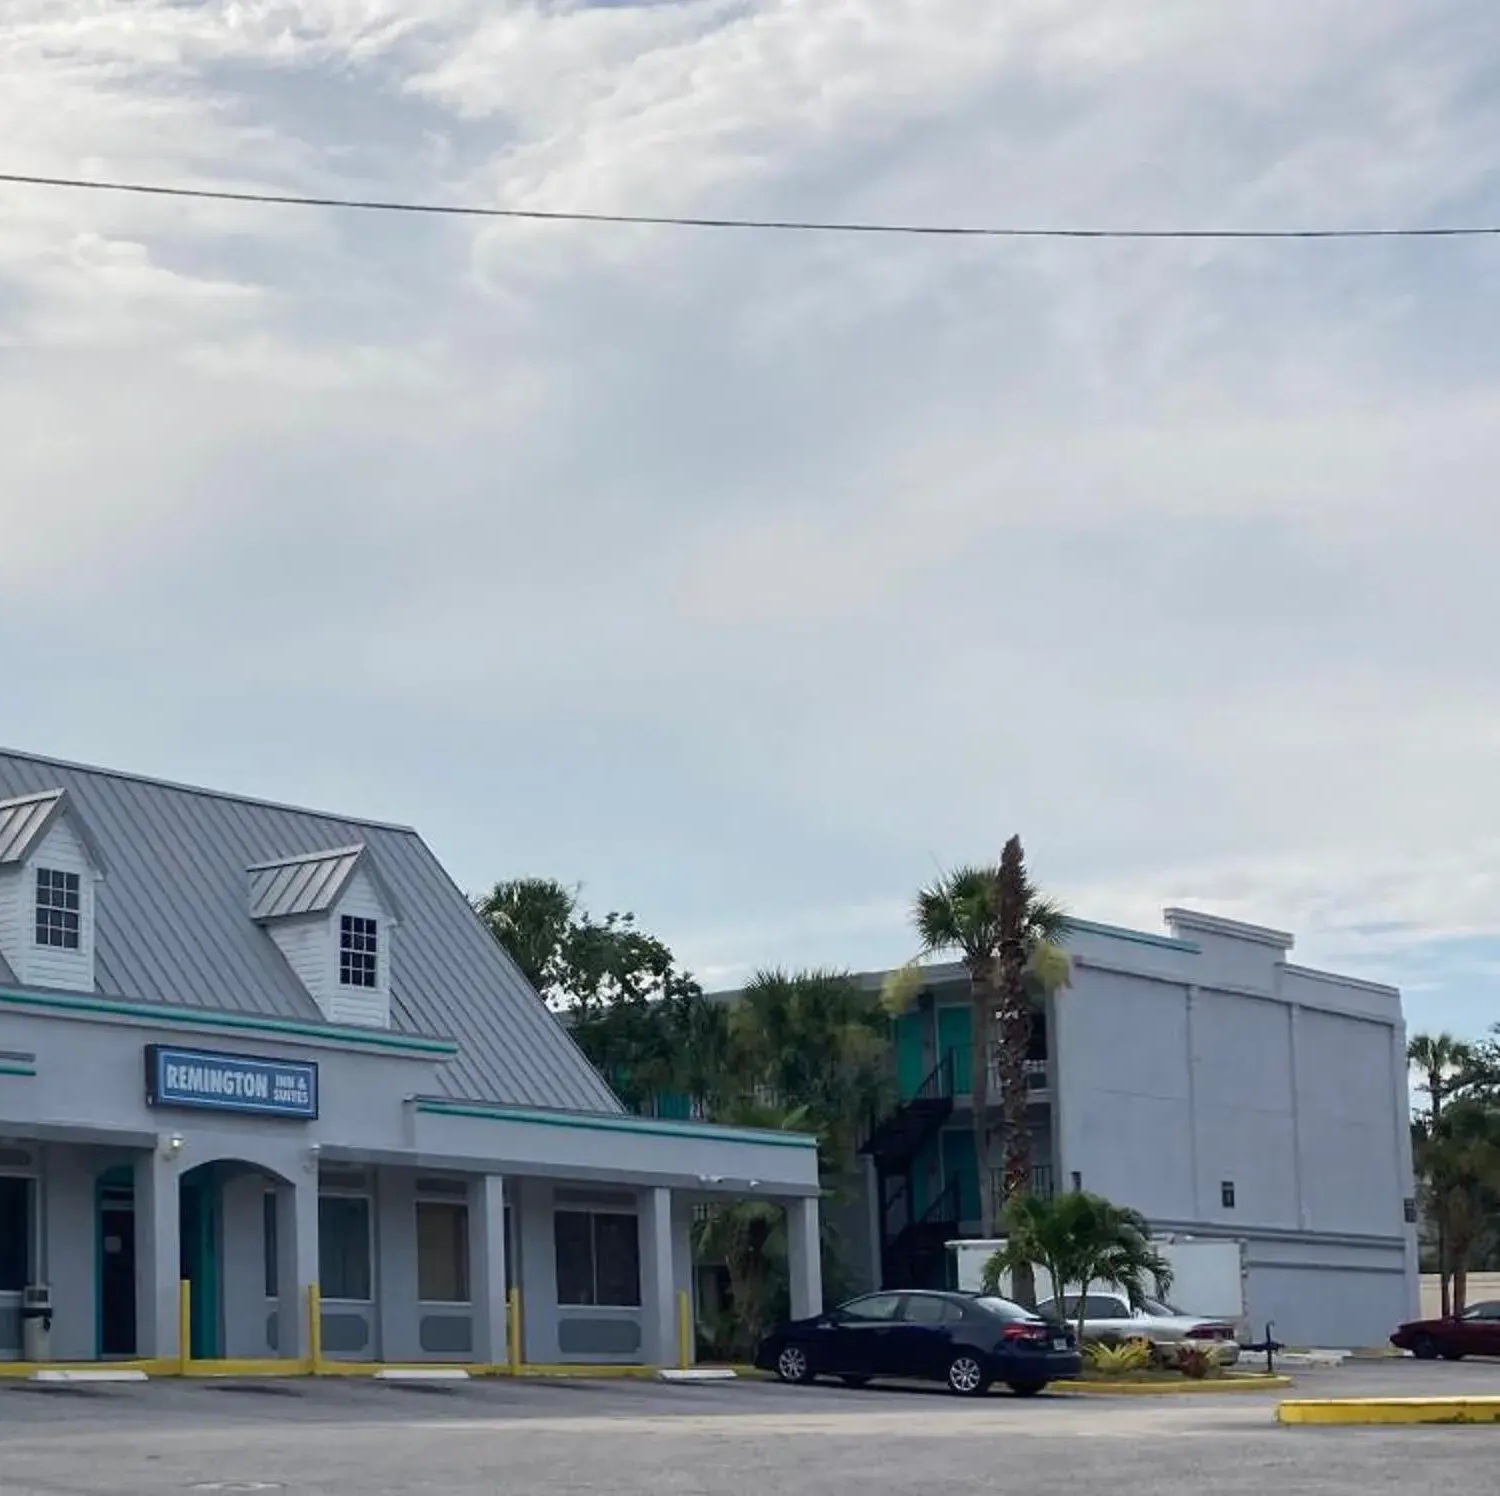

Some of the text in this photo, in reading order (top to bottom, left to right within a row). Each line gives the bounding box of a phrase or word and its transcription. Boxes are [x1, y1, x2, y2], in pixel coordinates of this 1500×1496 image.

[166, 1064, 268, 1098] REMINGTON
[275, 1074, 307, 1090] INN &
[273, 1088, 309, 1104] SUITES
